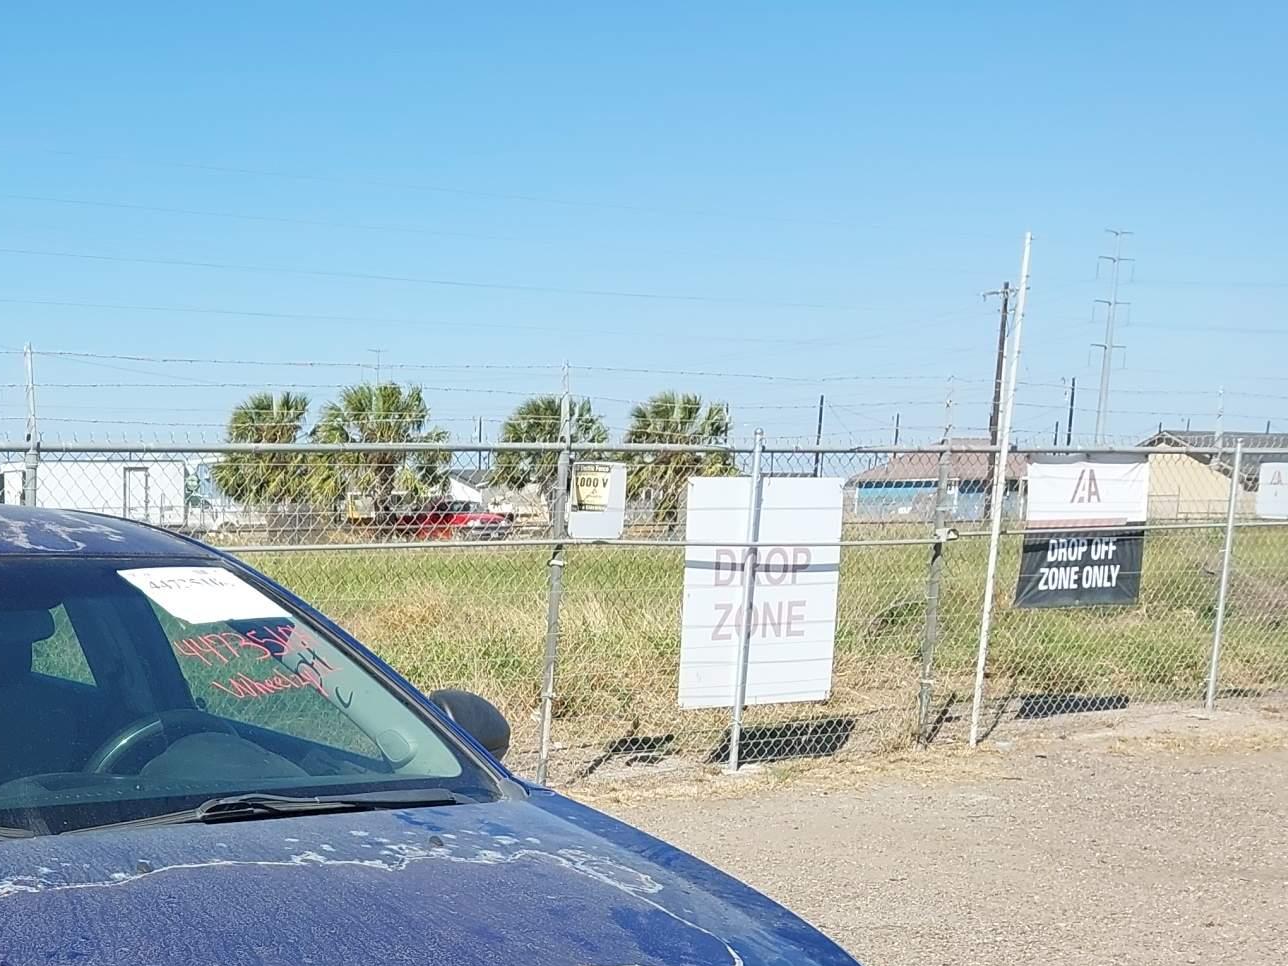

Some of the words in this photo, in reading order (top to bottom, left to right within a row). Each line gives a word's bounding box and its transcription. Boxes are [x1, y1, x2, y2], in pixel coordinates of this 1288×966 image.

[1046, 538, 1089, 562] DROP
[1090, 537, 1117, 561] OFF
[1038, 566, 1080, 591] ZONE
[1081, 565, 1121, 589] ONLY
[711, 600, 807, 641] ZONE
